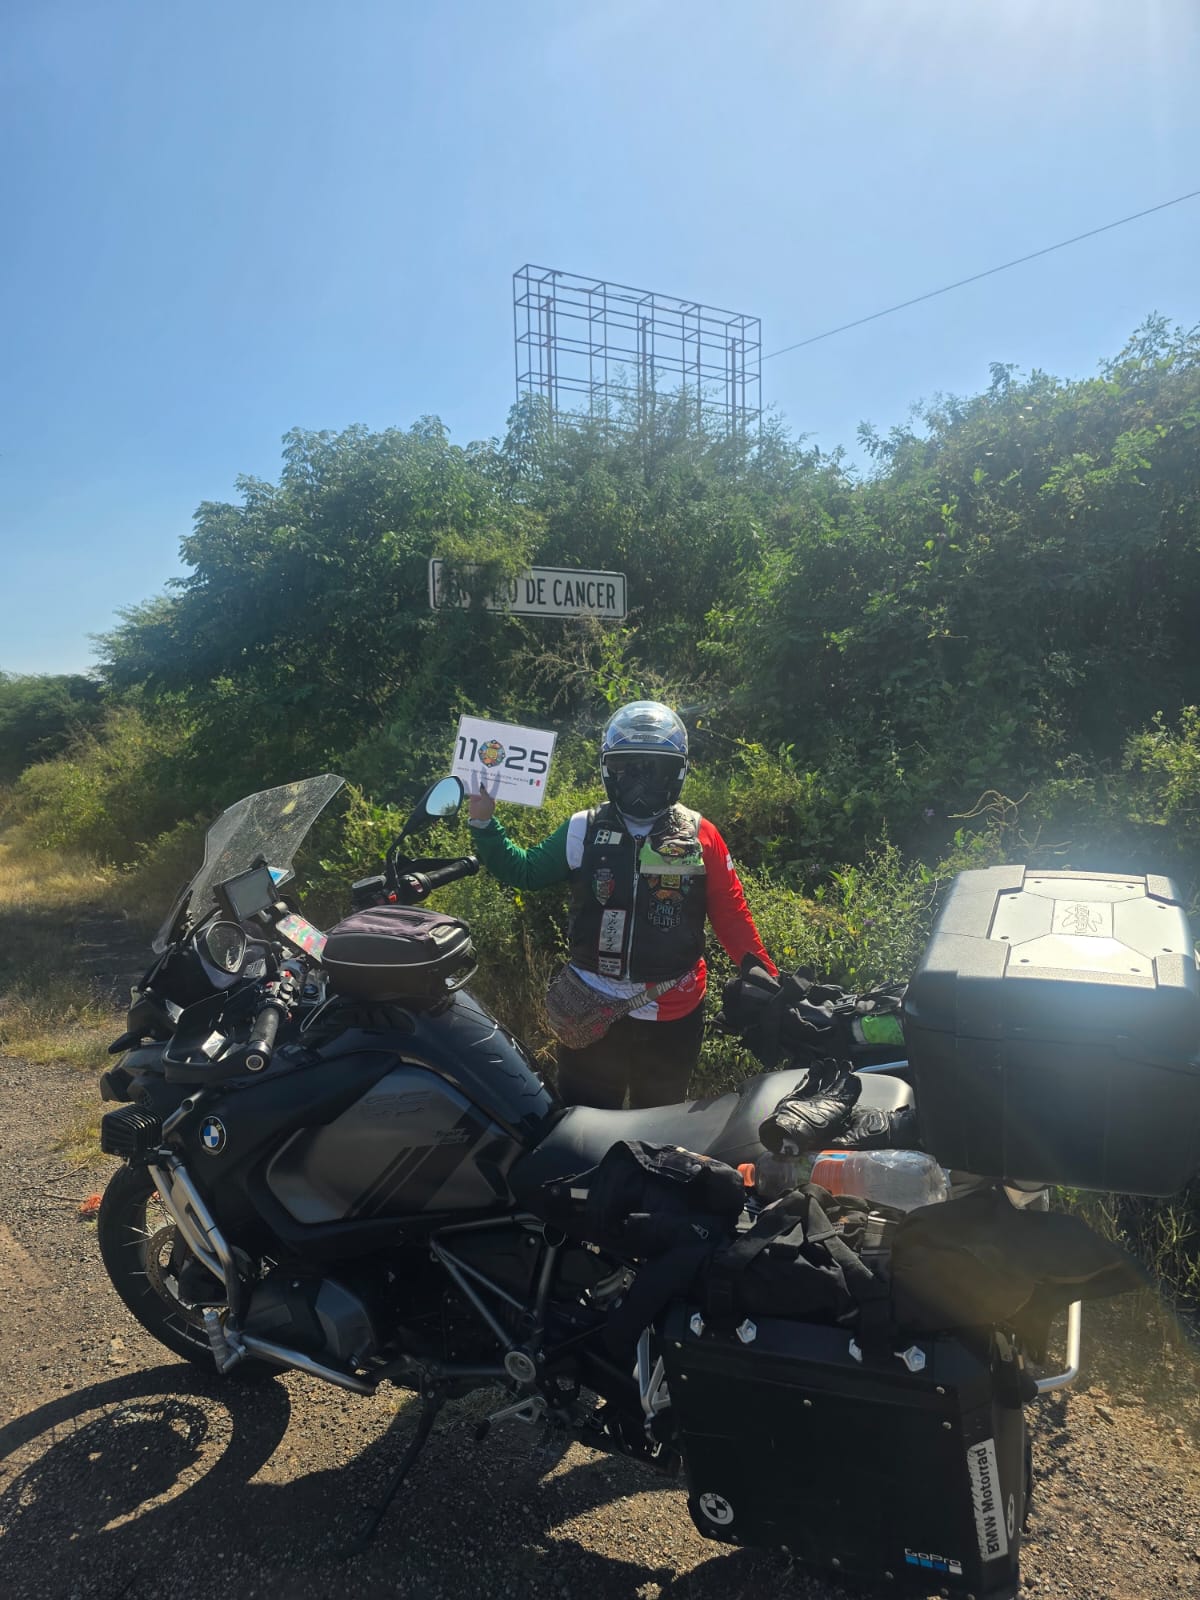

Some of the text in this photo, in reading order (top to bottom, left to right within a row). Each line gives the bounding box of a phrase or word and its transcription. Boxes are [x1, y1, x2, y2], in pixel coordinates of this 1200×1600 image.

[526, 578, 547, 605] DE
[553, 579, 616, 609] CANCER
[974, 1447, 999, 1553] BMW Motorrad
[904, 1548, 961, 1566] GoPro
